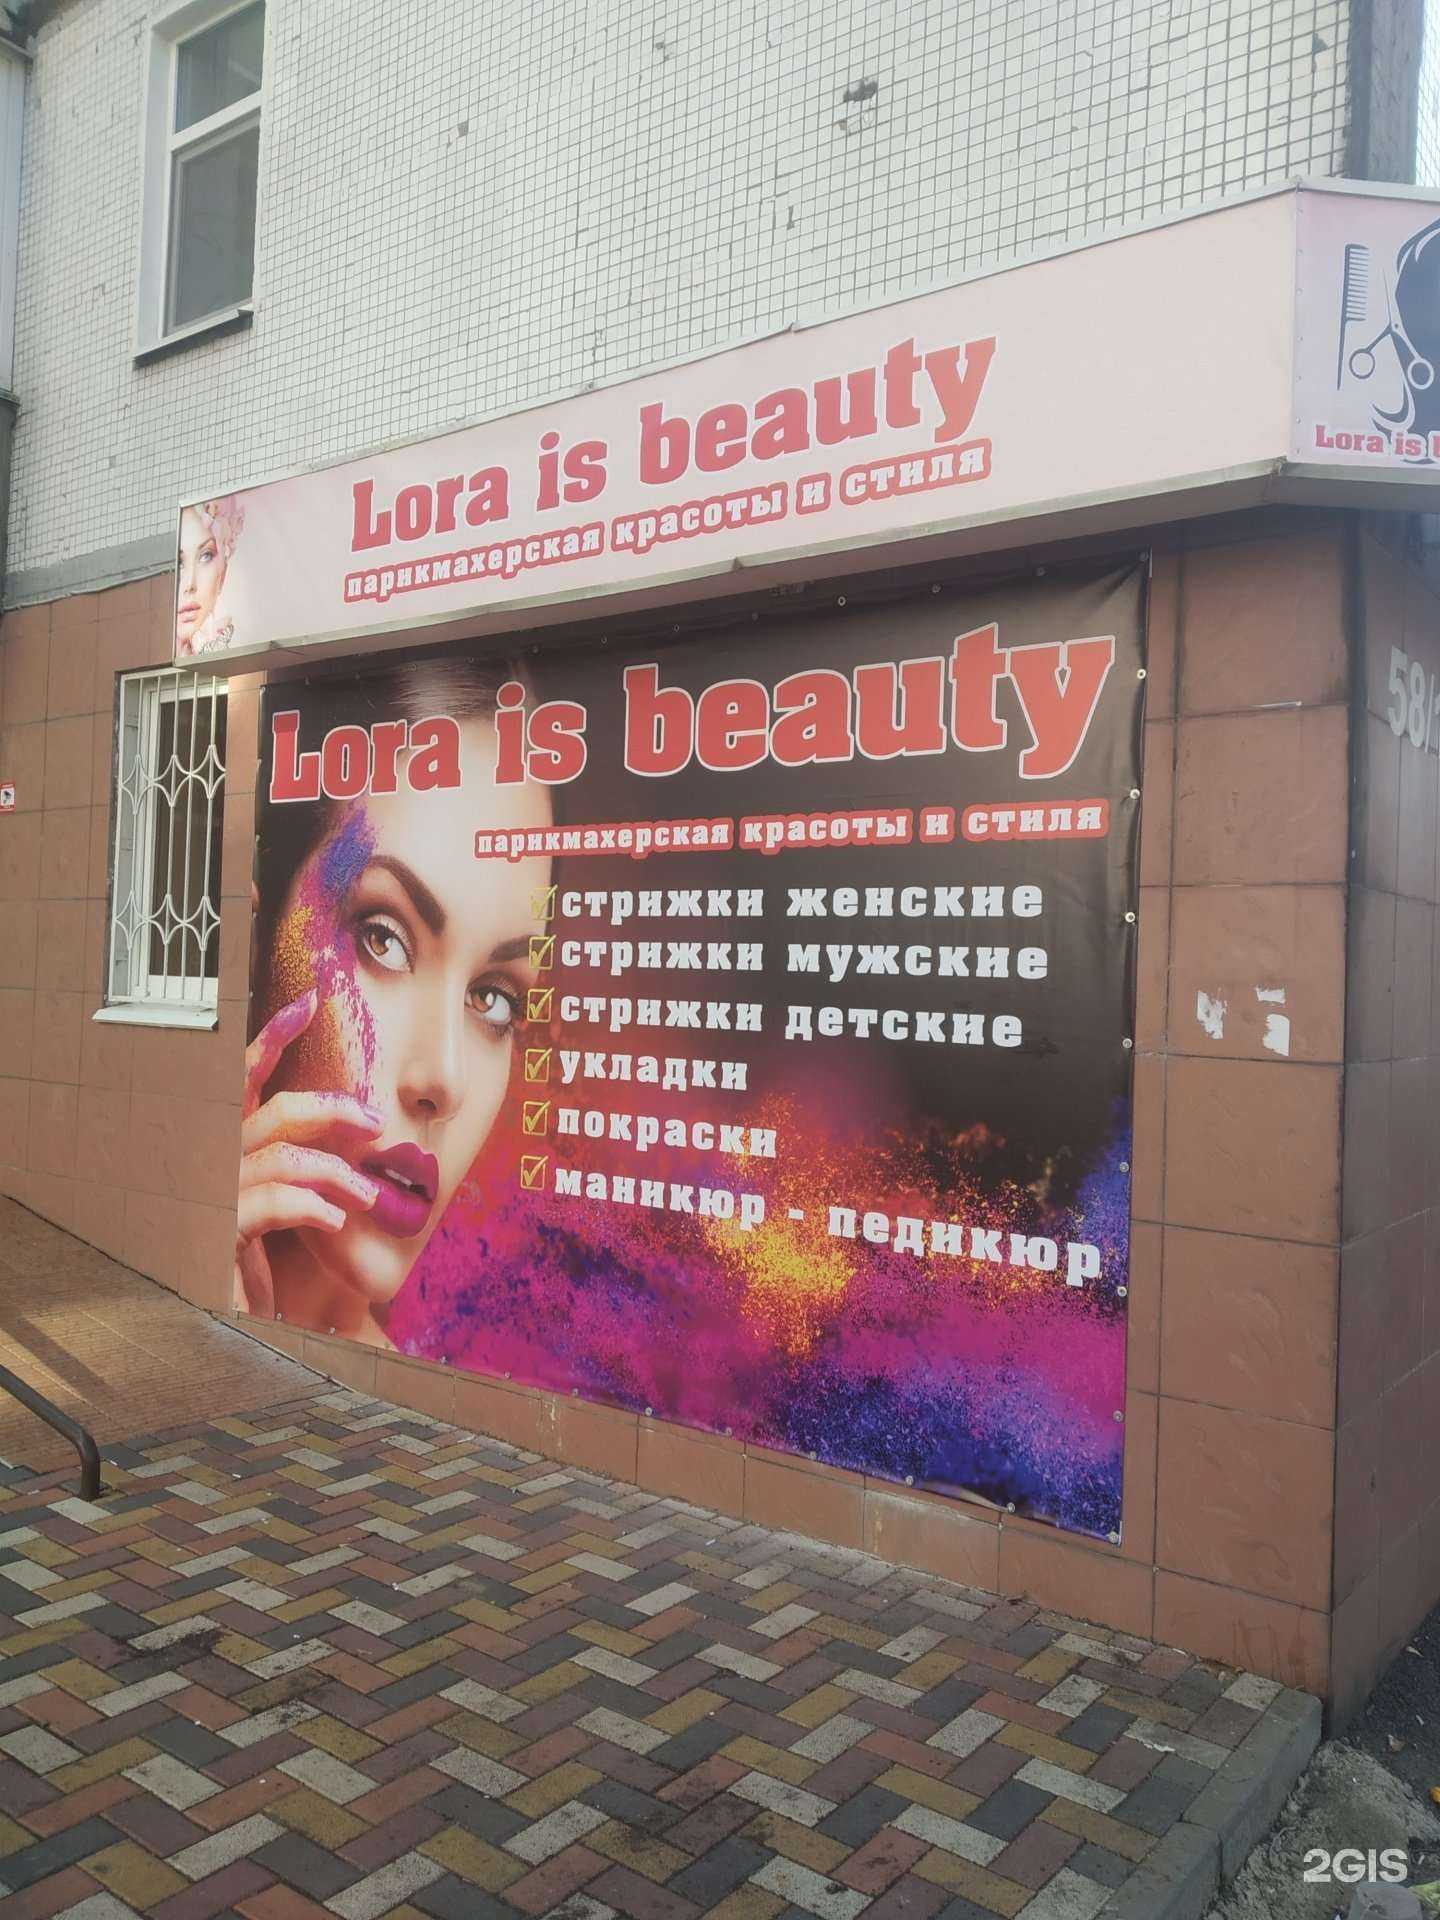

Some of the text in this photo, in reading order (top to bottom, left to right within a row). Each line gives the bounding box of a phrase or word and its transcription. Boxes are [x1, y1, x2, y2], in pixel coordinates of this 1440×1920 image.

[351, 337, 997, 551] Lora is beauty
[1315, 424, 1383, 453] Lora
[1395, 431, 1422, 456] is
[347, 445, 985, 599] парикмахерская красоты и стиля
[270, 622, 1115, 803] Lora is beauty
[478, 806, 1102, 859] парикмахерская красоты и стиля
[561, 884, 1043, 925] стрижки женские
[560, 937, 1049, 983] стрижки мужские
[560, 995, 1023, 1048] стрижки детские
[559, 1049, 749, 1092] укладки
[557, 1106, 777, 1159] покраски
[555, 1167, 766, 1232] маникюр
[829, 1205, 1101, 1289] педикюр
